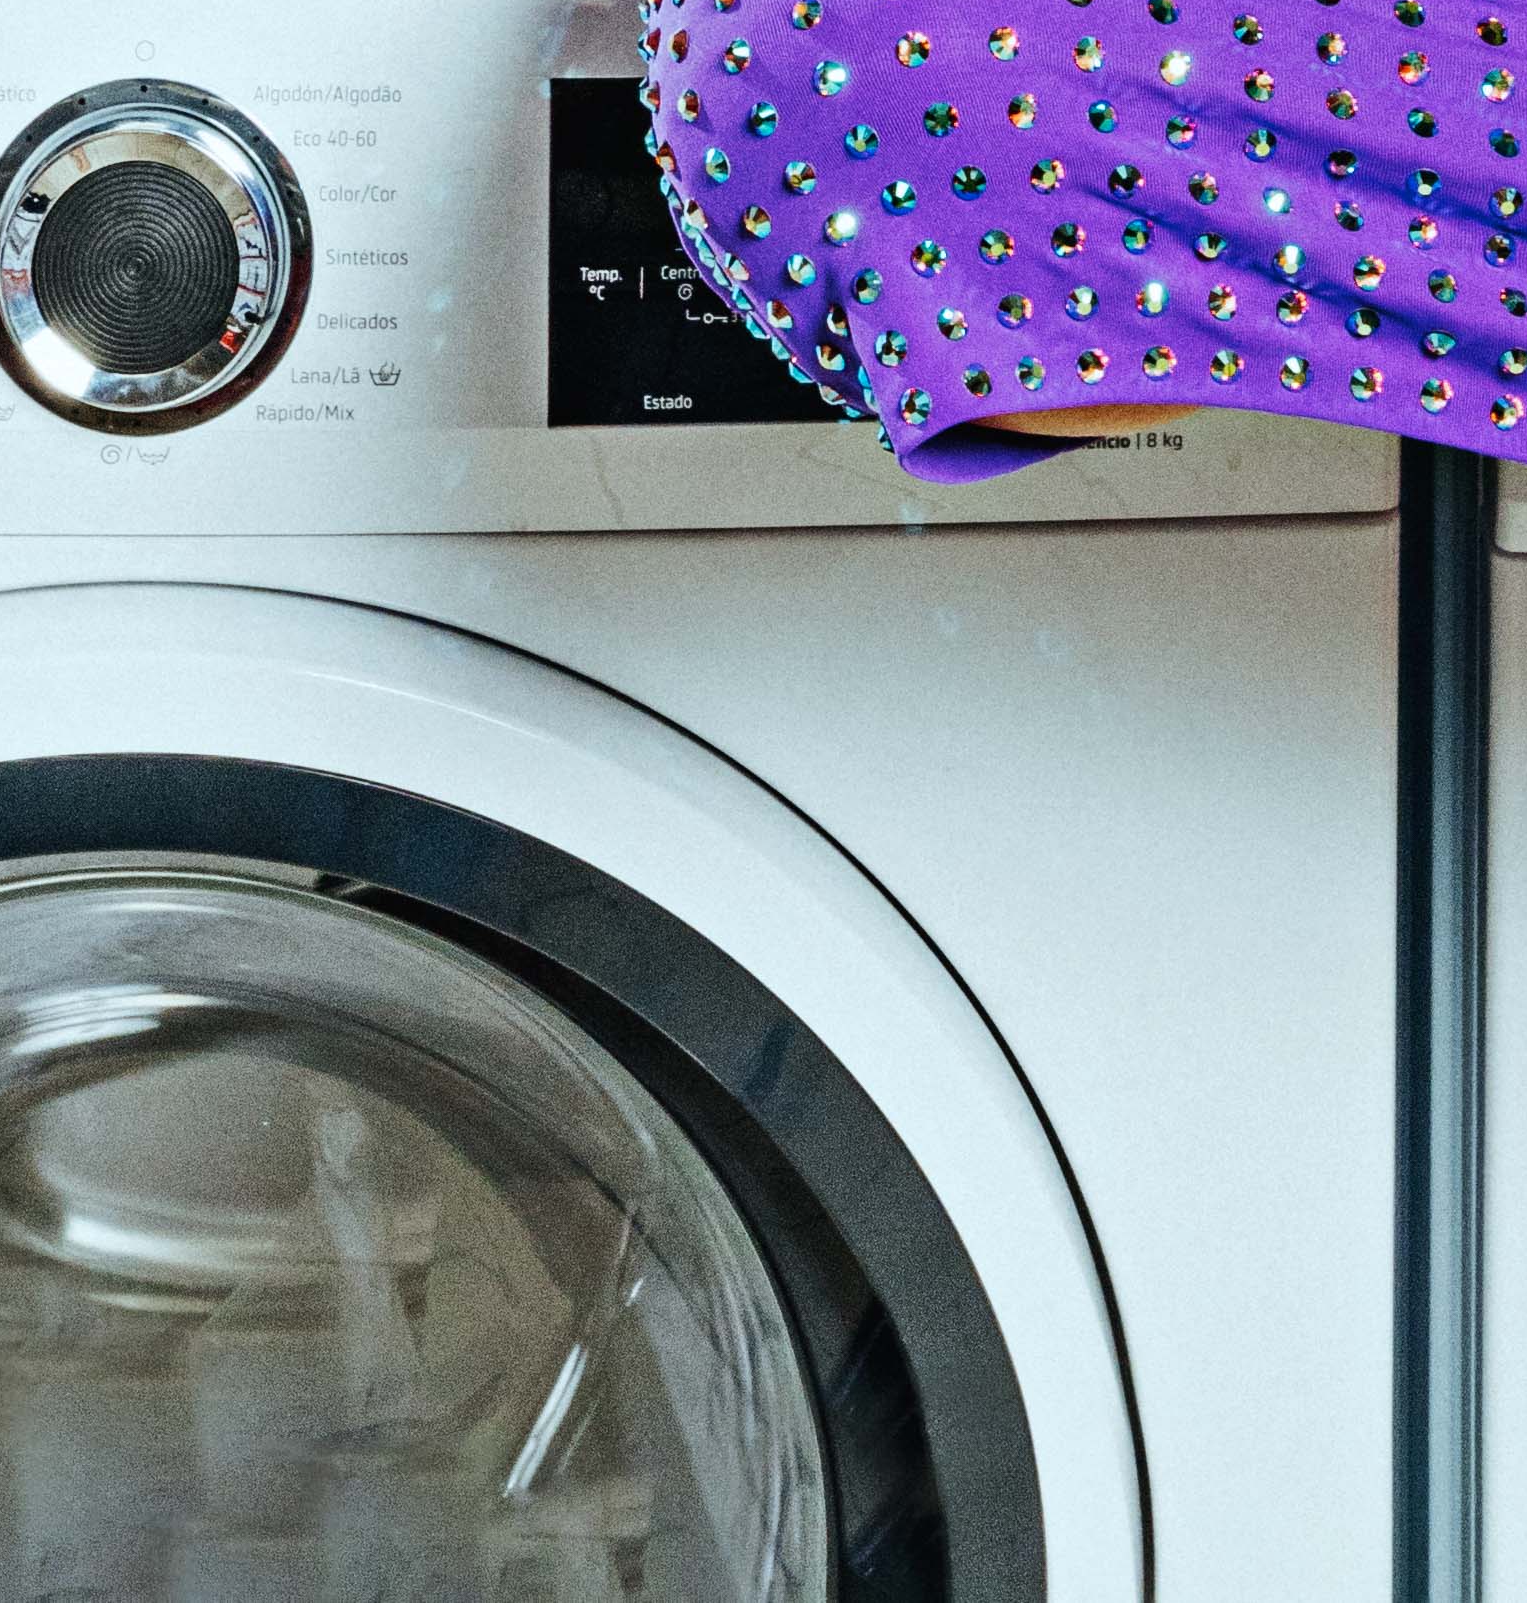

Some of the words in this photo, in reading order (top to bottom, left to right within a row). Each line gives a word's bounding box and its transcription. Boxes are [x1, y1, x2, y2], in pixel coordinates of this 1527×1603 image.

[253, 84, 402, 105] Algodón/Algodão
[293, 130, 322, 148] Eco
[326, 130, 377, 149] 40-60
[318, 186, 397, 203] Color/Cor
[325, 248, 409, 267] Sintéticos
[580, 267, 623, 282] Temp.
[317, 313, 398, 331] Delicados
[290, 366, 360, 386] Lana/Lã
[643, 395, 693, 410] Estado
[1147, 432, 1157, 448] 8
[1163, 432, 1183, 450] kg
